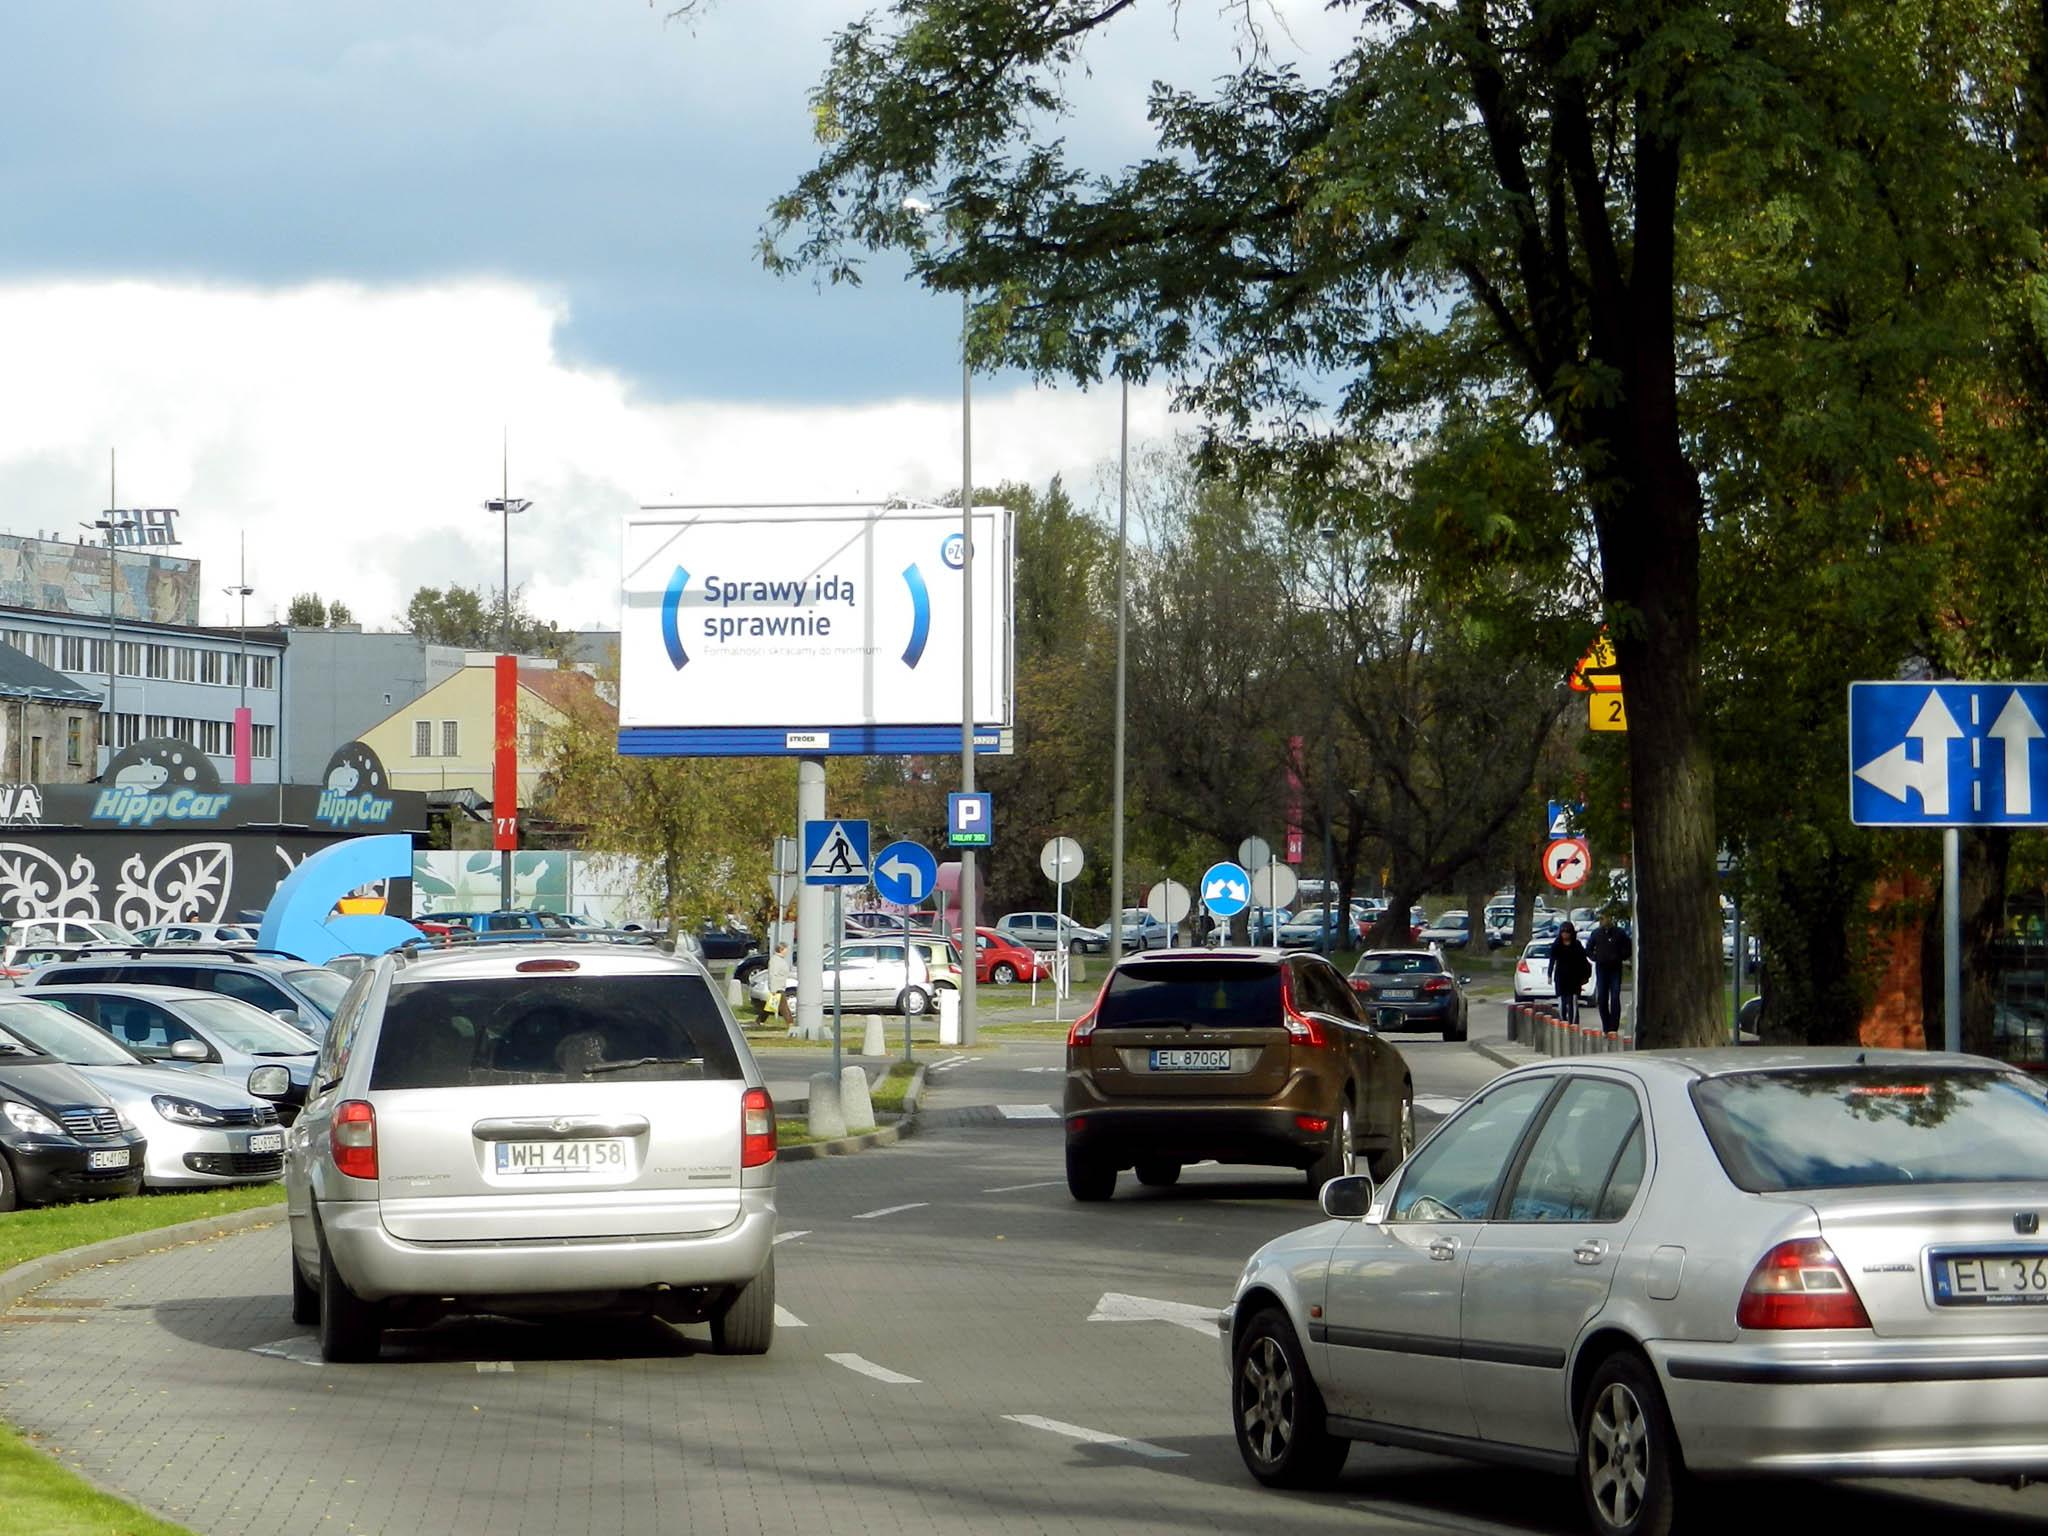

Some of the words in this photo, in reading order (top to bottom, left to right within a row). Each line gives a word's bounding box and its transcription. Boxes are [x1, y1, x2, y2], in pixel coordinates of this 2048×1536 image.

[704, 576, 807, 607] Sprawy
[815, 575, 854, 606] idą
[704, 610, 831, 643] sprawnie
[1608, 700, 1622, 722] 2
[92, 789, 229, 826] HippCar
[316, 791, 393, 828] HippCar
[959, 800, 980, 829] P
[497, 818, 516, 835] 77
[1159, 1052, 1178, 1066] EL
[1183, 1052, 1228, 1066] 870GK
[512, 1145, 545, 1166] WH
[552, 1144, 621, 1166] 44158
[1954, 1260, 1999, 1292] EL
